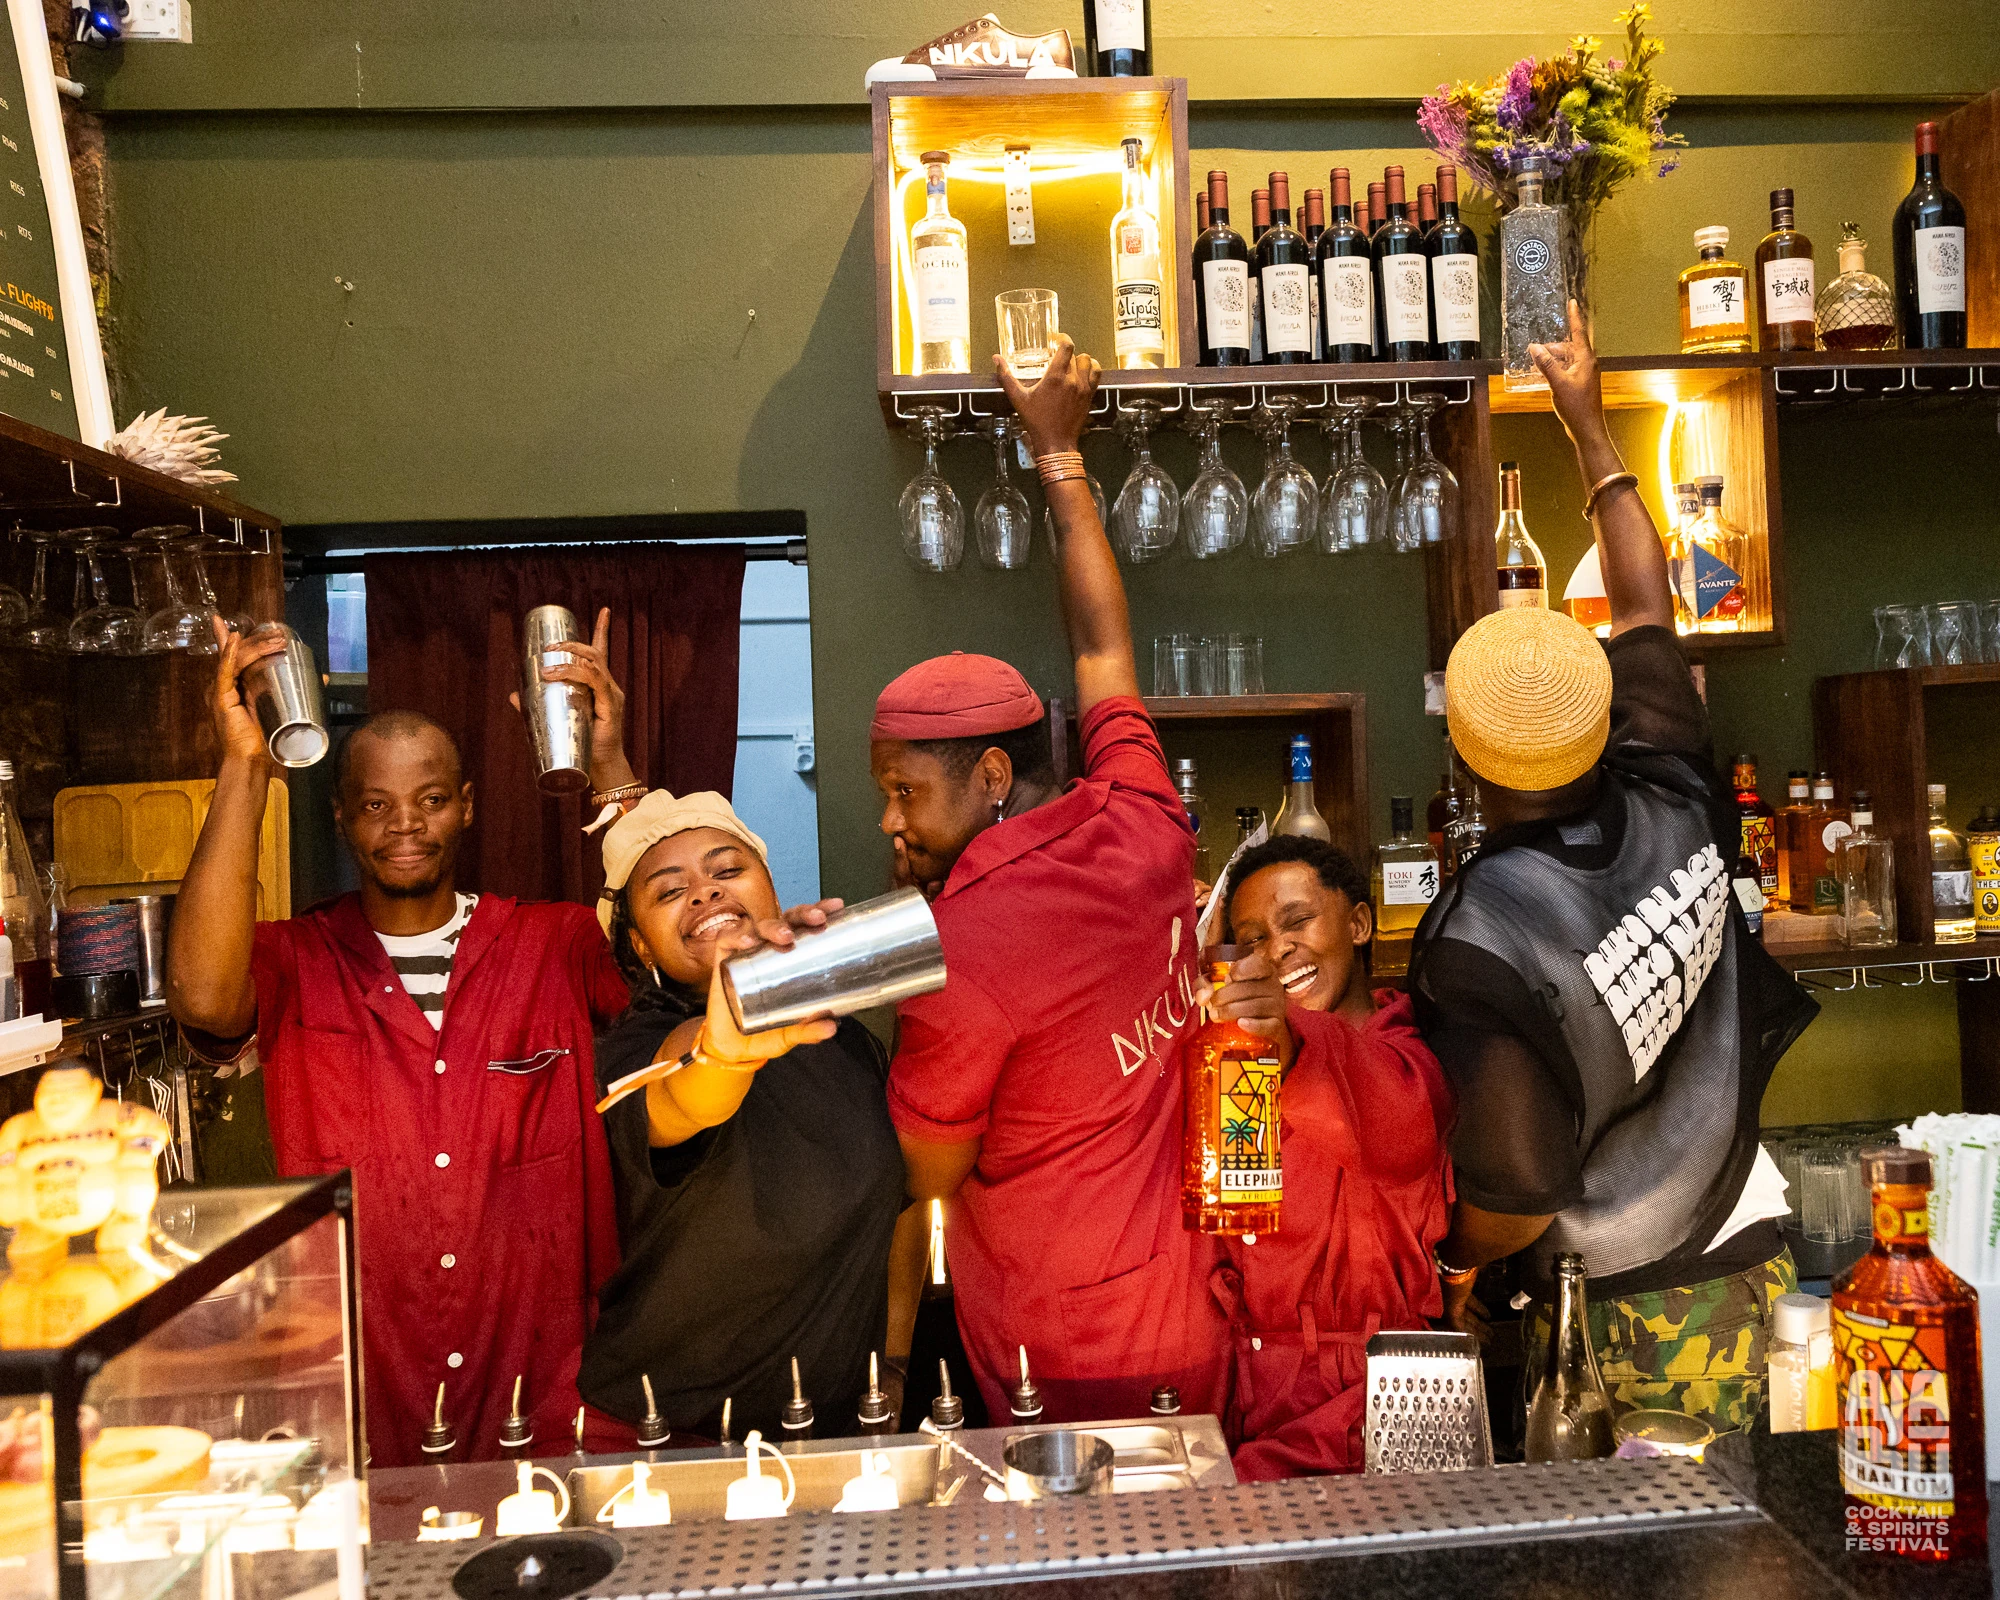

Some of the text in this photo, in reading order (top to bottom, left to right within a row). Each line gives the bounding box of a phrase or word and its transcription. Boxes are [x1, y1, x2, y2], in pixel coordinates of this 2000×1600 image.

[928, 39, 1056, 67] NKULA
[1518, 242, 1546, 257] ALBATROSS
[922, 260, 959, 269] OCHO
[1522, 261, 1544, 271] VODKA
[7, 282, 54, 322] FLIGHTS
[1699, 579, 1735, 589] AVANTE
[1388, 871, 1413, 880] TOKI
[1635, 843, 1725, 934] BLACK
